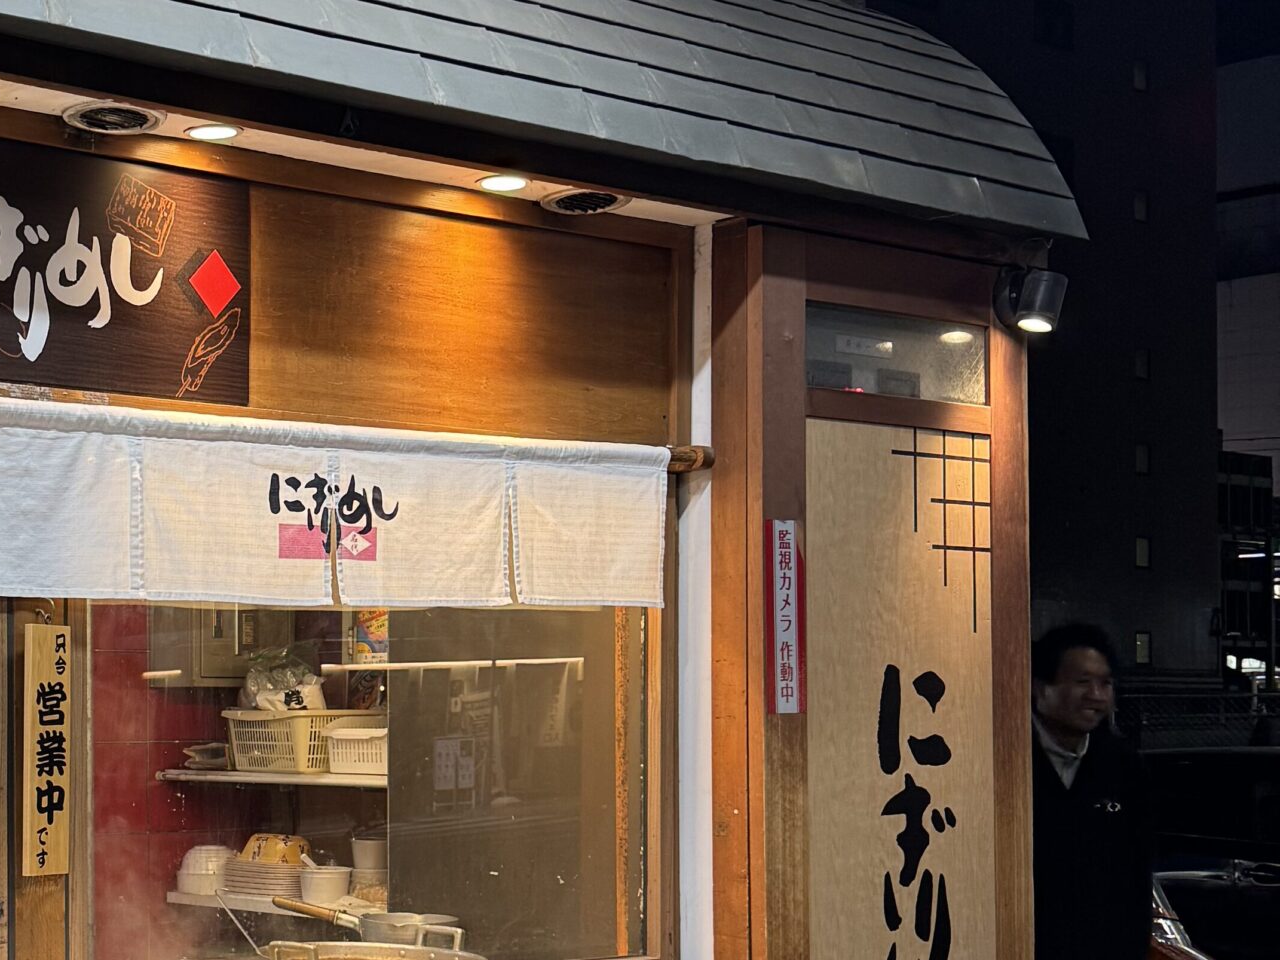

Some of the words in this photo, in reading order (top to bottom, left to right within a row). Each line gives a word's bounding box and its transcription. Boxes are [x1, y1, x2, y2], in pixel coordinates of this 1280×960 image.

[269, 473, 399, 553] にぎりめし
